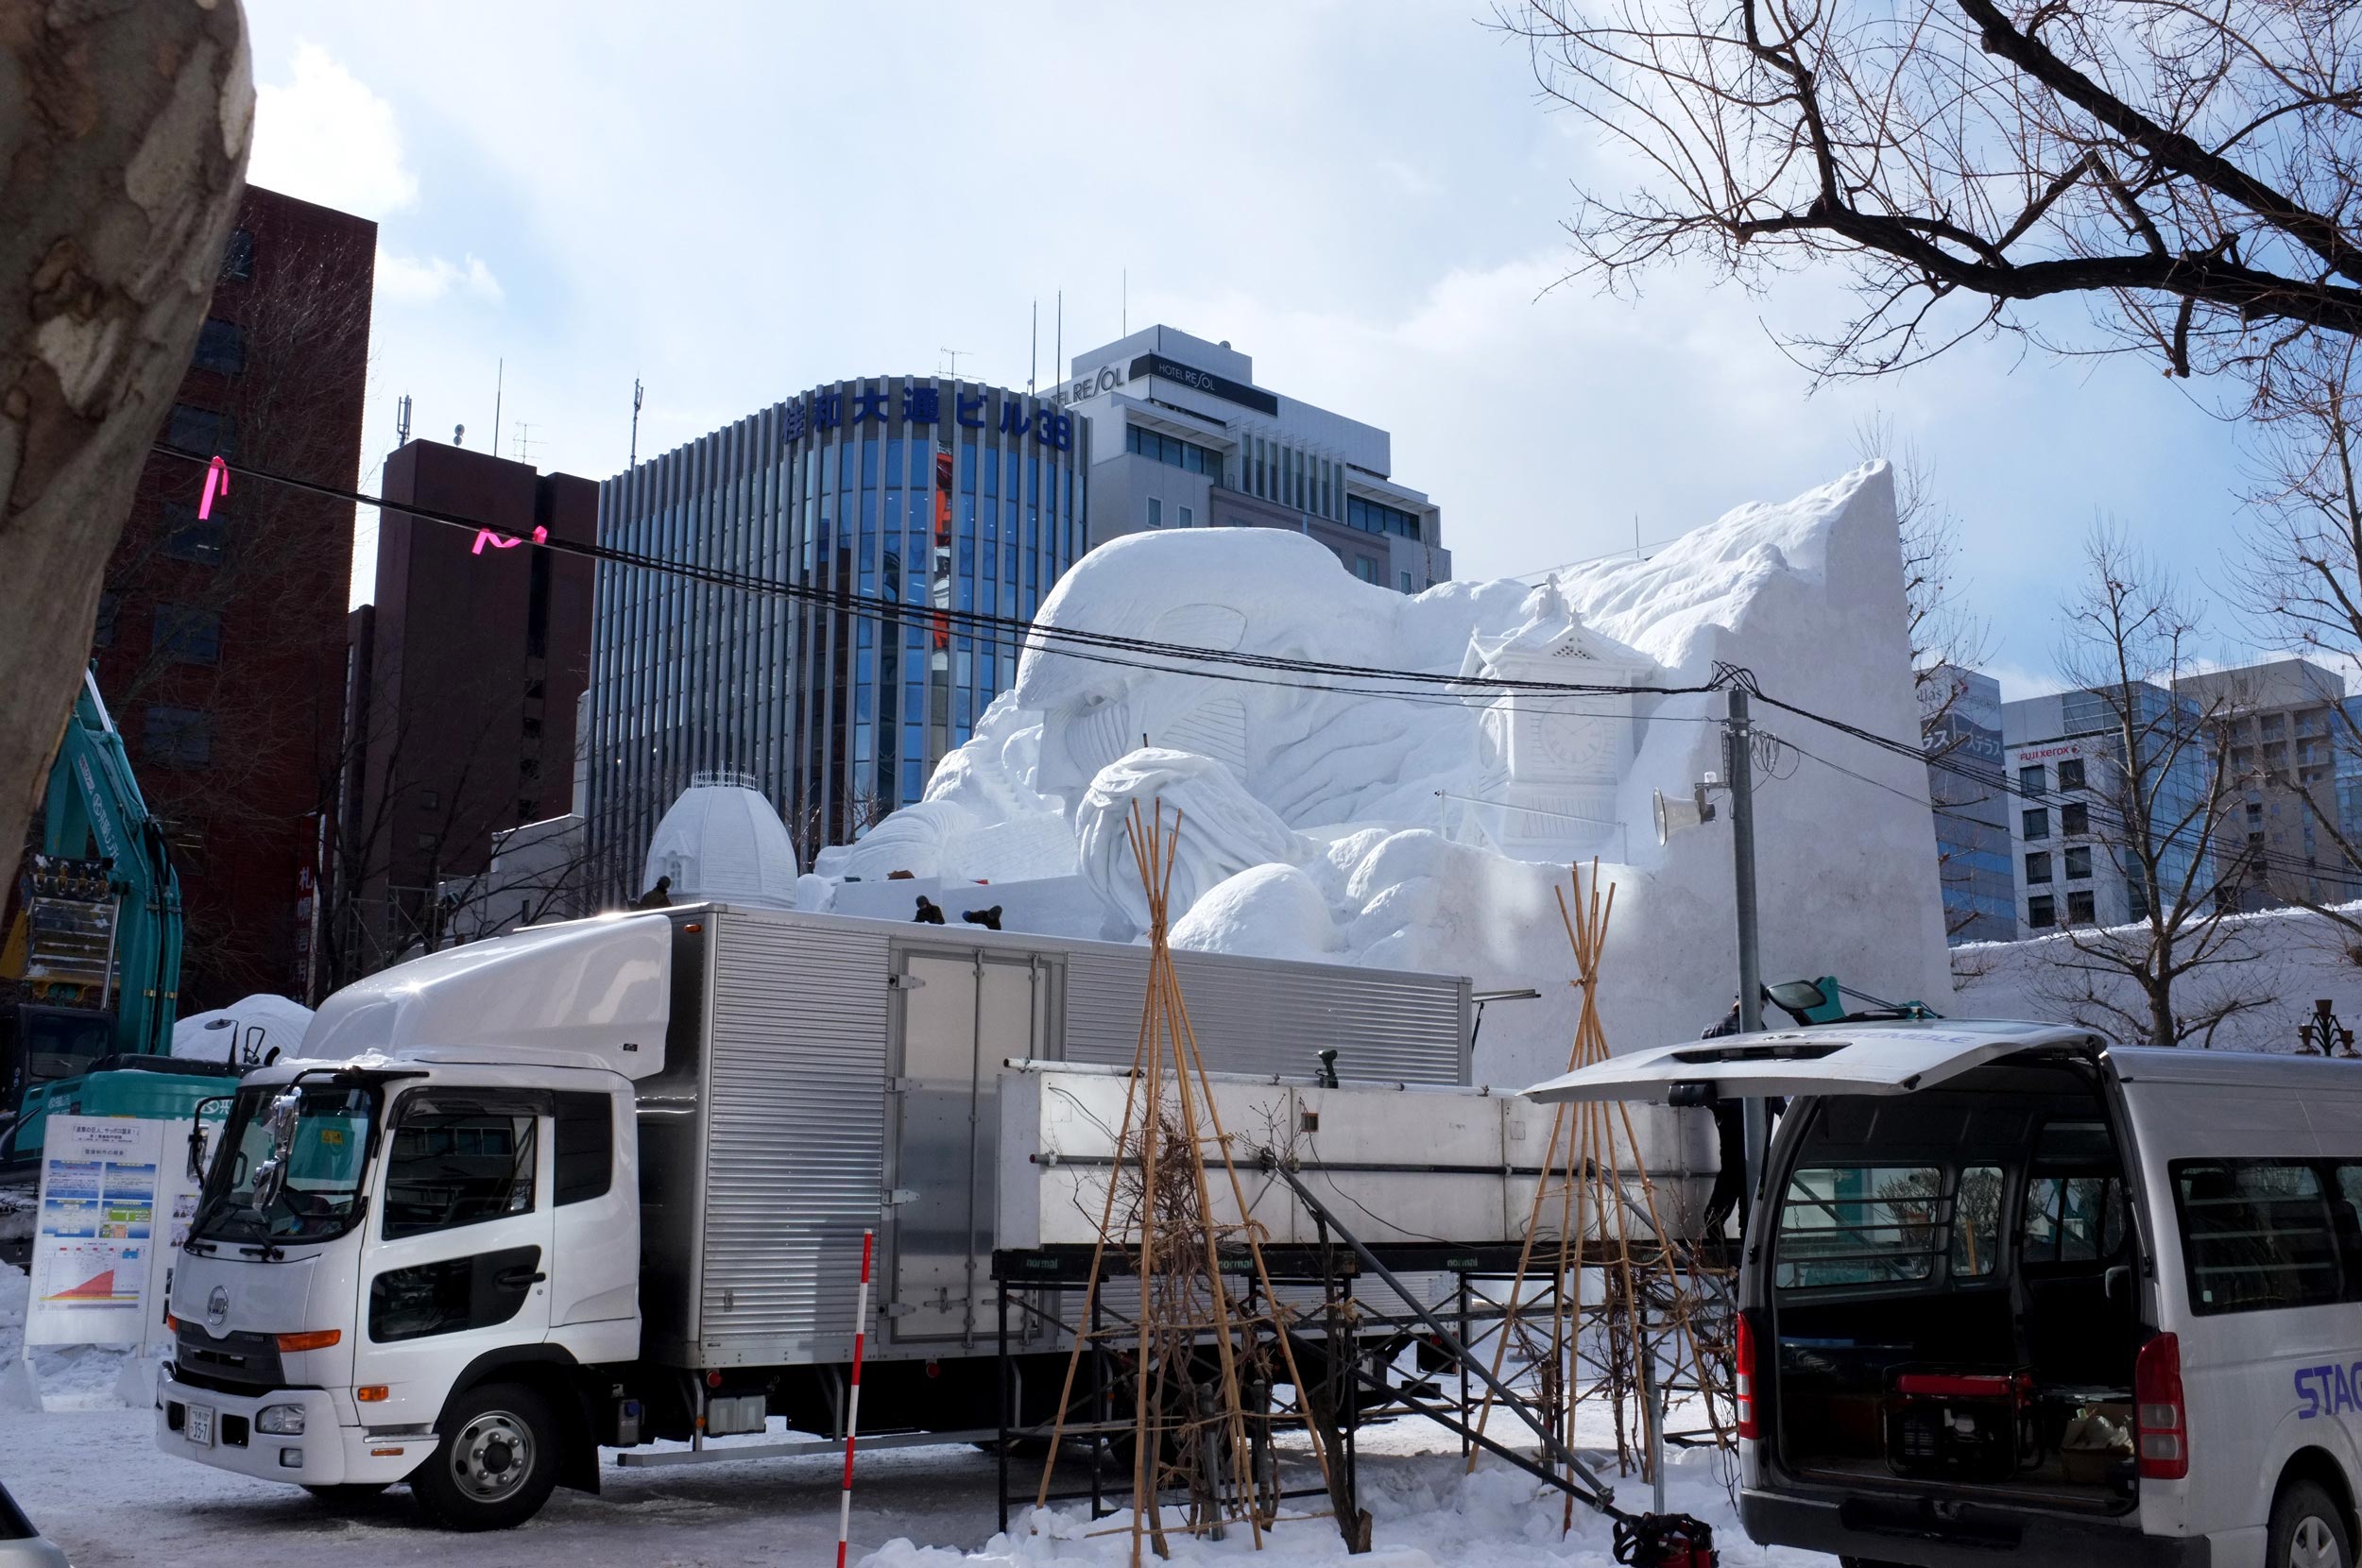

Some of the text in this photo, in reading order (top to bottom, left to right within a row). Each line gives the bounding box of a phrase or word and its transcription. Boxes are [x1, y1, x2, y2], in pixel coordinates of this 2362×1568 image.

[1073, 366, 1125, 403] RESOL
[1159, 364, 1216, 391] HOTEL RESOL
[782, 387, 1072, 452] 桂和大通ビル38
[2020, 746, 2069, 760] FUJI xerox
[1026, 1258, 1058, 1270] normal
[1446, 1257, 1479, 1268] normal
